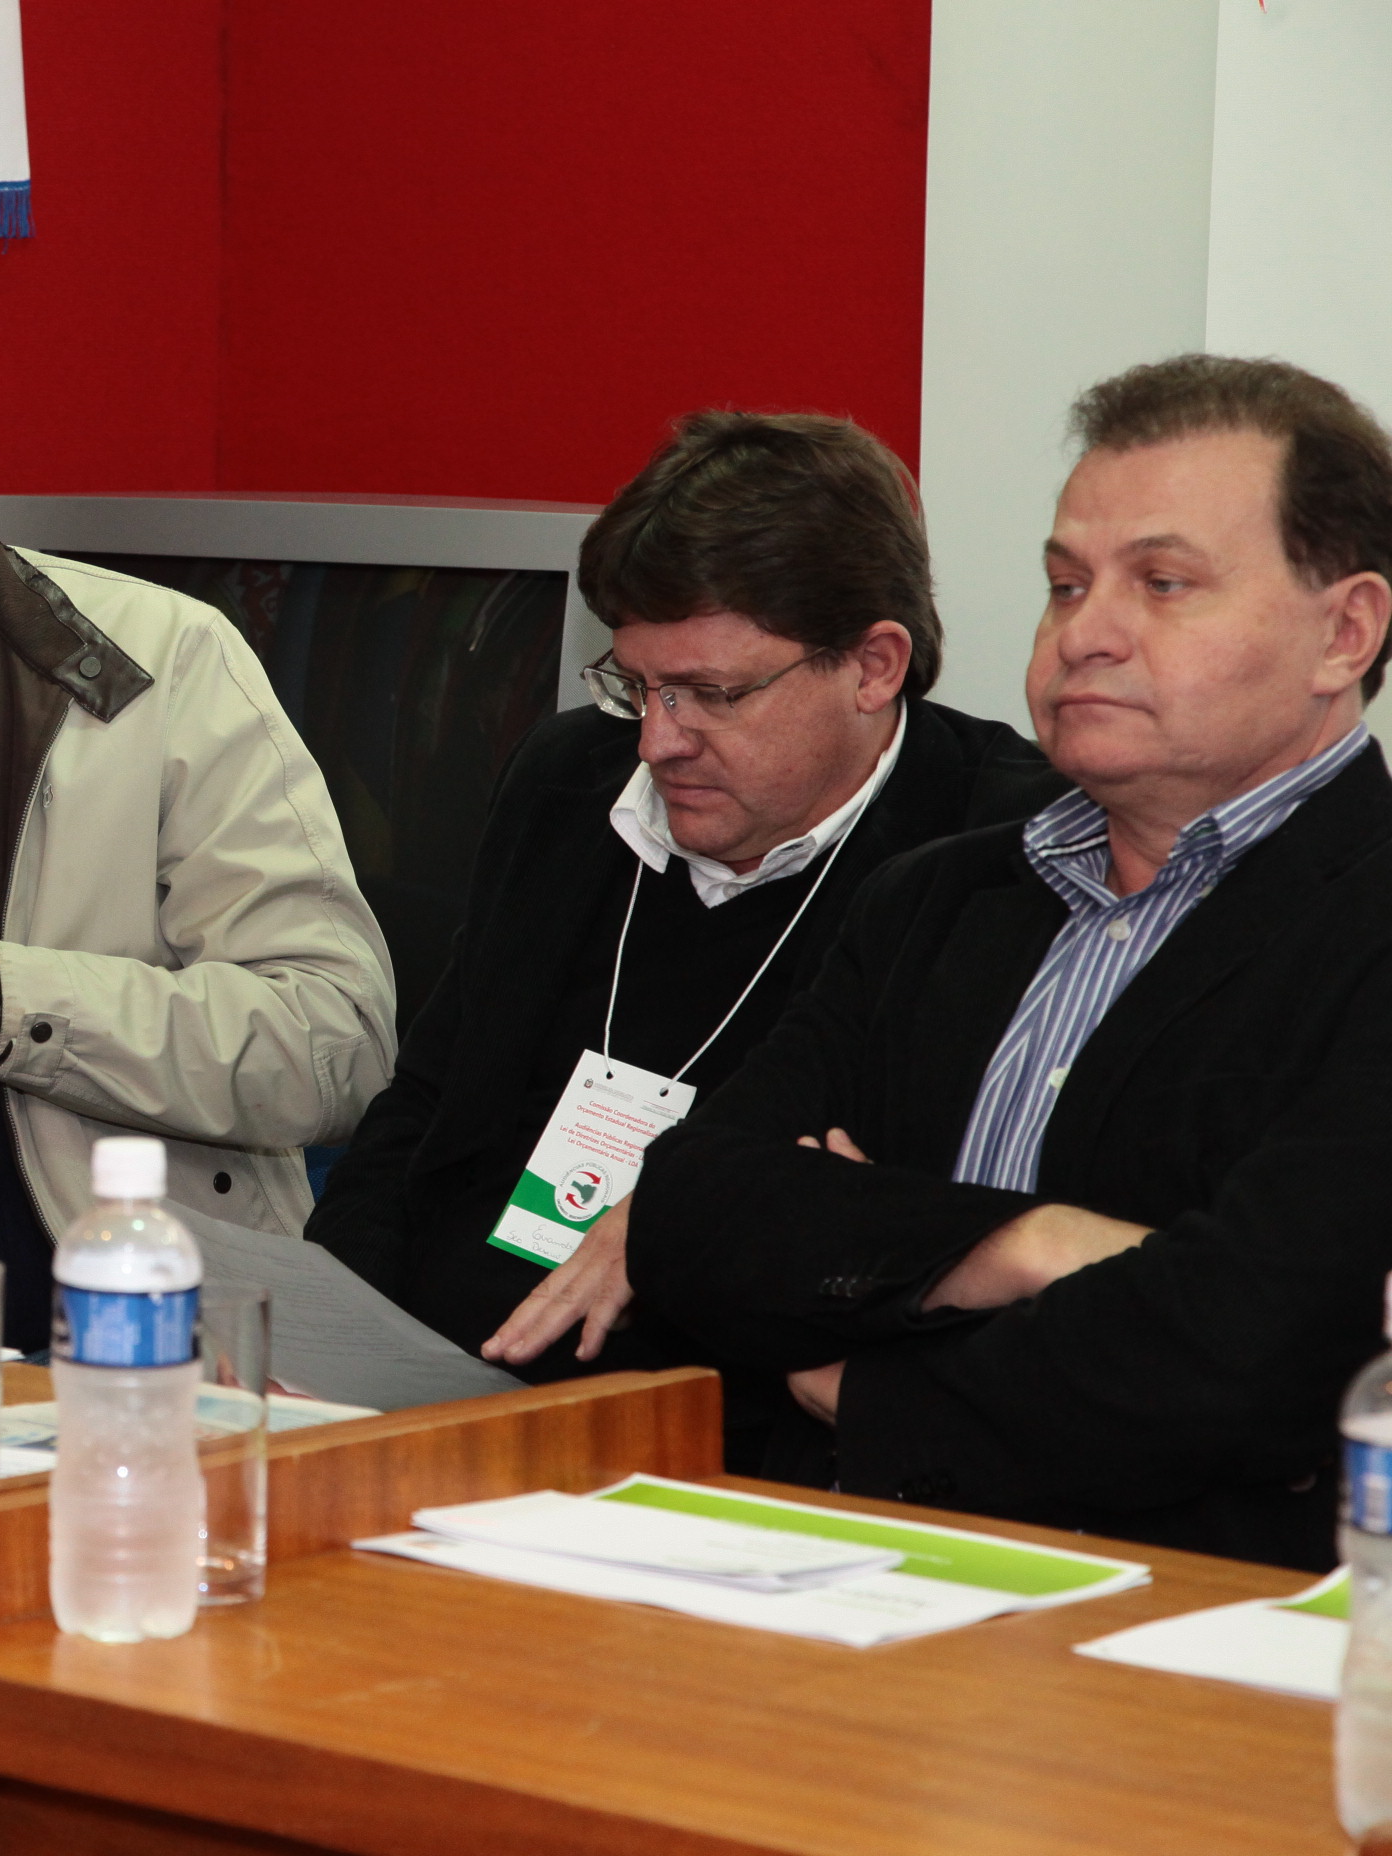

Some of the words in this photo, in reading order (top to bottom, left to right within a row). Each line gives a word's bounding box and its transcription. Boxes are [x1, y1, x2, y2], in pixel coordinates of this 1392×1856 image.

[577, 1104, 605, 1119] Orçamento
[605, 1115, 626, 1127] Estadual
[589, 1101, 613, 1113] Comissão
[614, 1109, 648, 1126] Coordenadora
[575, 1122, 602, 1136] Audiências
[603, 1132, 623, 1144] Públicas
[575, 1131, 600, 1145] Diretrizes
[600, 1141, 635, 1158] Orçamentárias
[576, 1141, 610, 1157] Orçamentária
[610, 1153, 625, 1163] Anual
